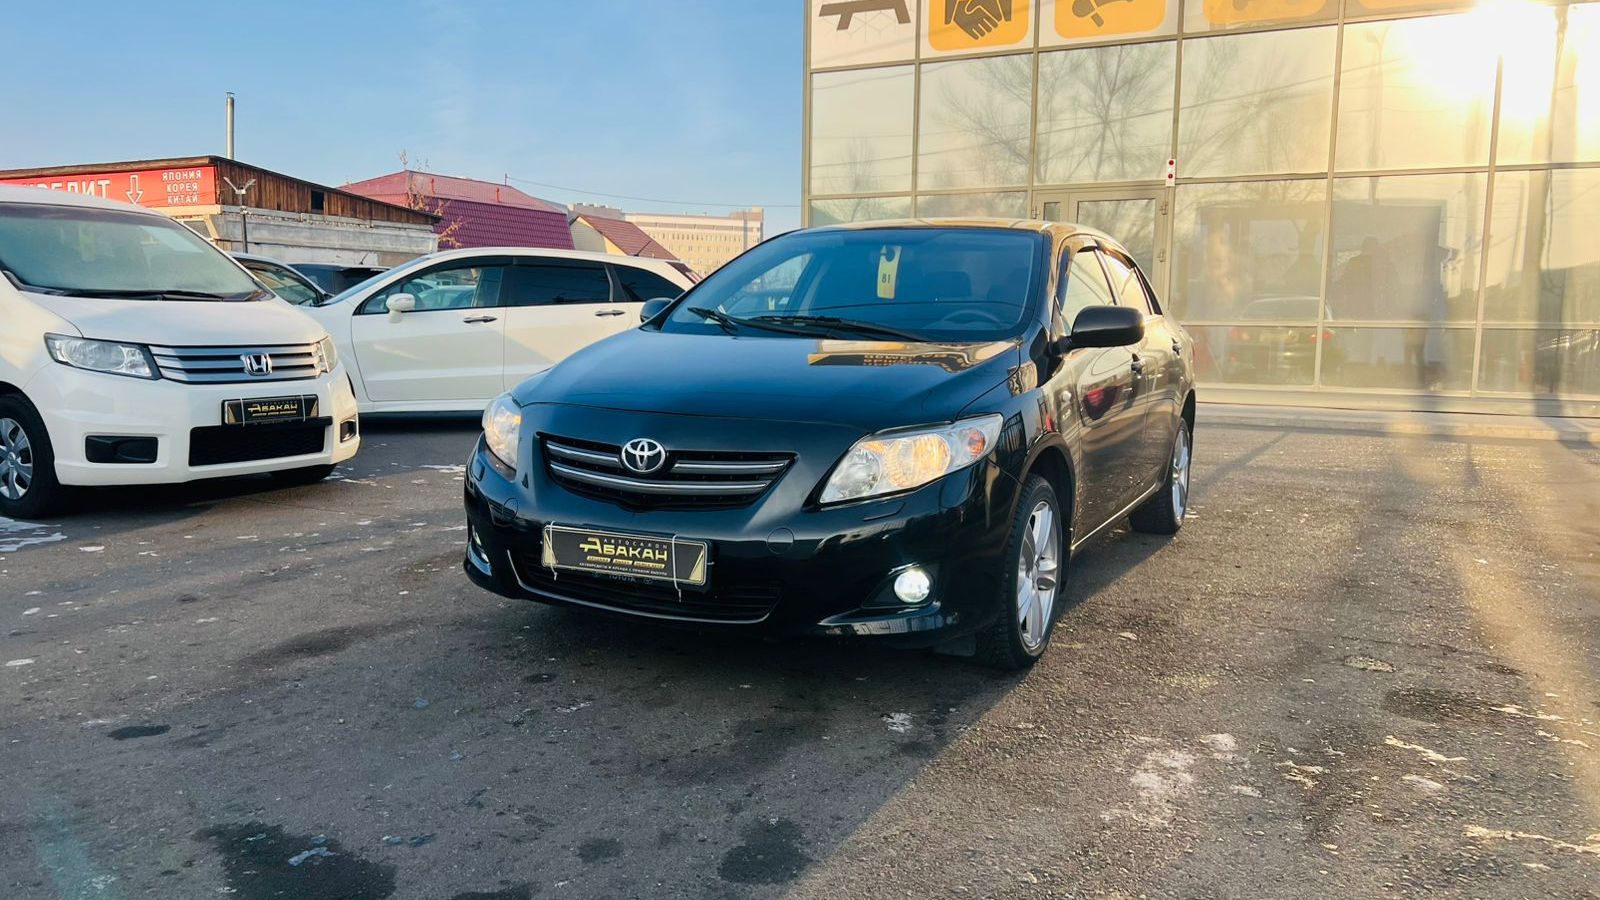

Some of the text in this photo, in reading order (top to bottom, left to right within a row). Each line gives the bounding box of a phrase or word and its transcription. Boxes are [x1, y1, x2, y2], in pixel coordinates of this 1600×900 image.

[162, 170, 202, 181] ЯПОНИЯ
[23, 179, 110, 199] ДИТ
[166, 182, 198, 193] КОРЕЯ
[167, 191, 198, 204] КИТАЙ
[881, 272, 891, 284] 81
[579, 537, 668, 561] АБАКАН
